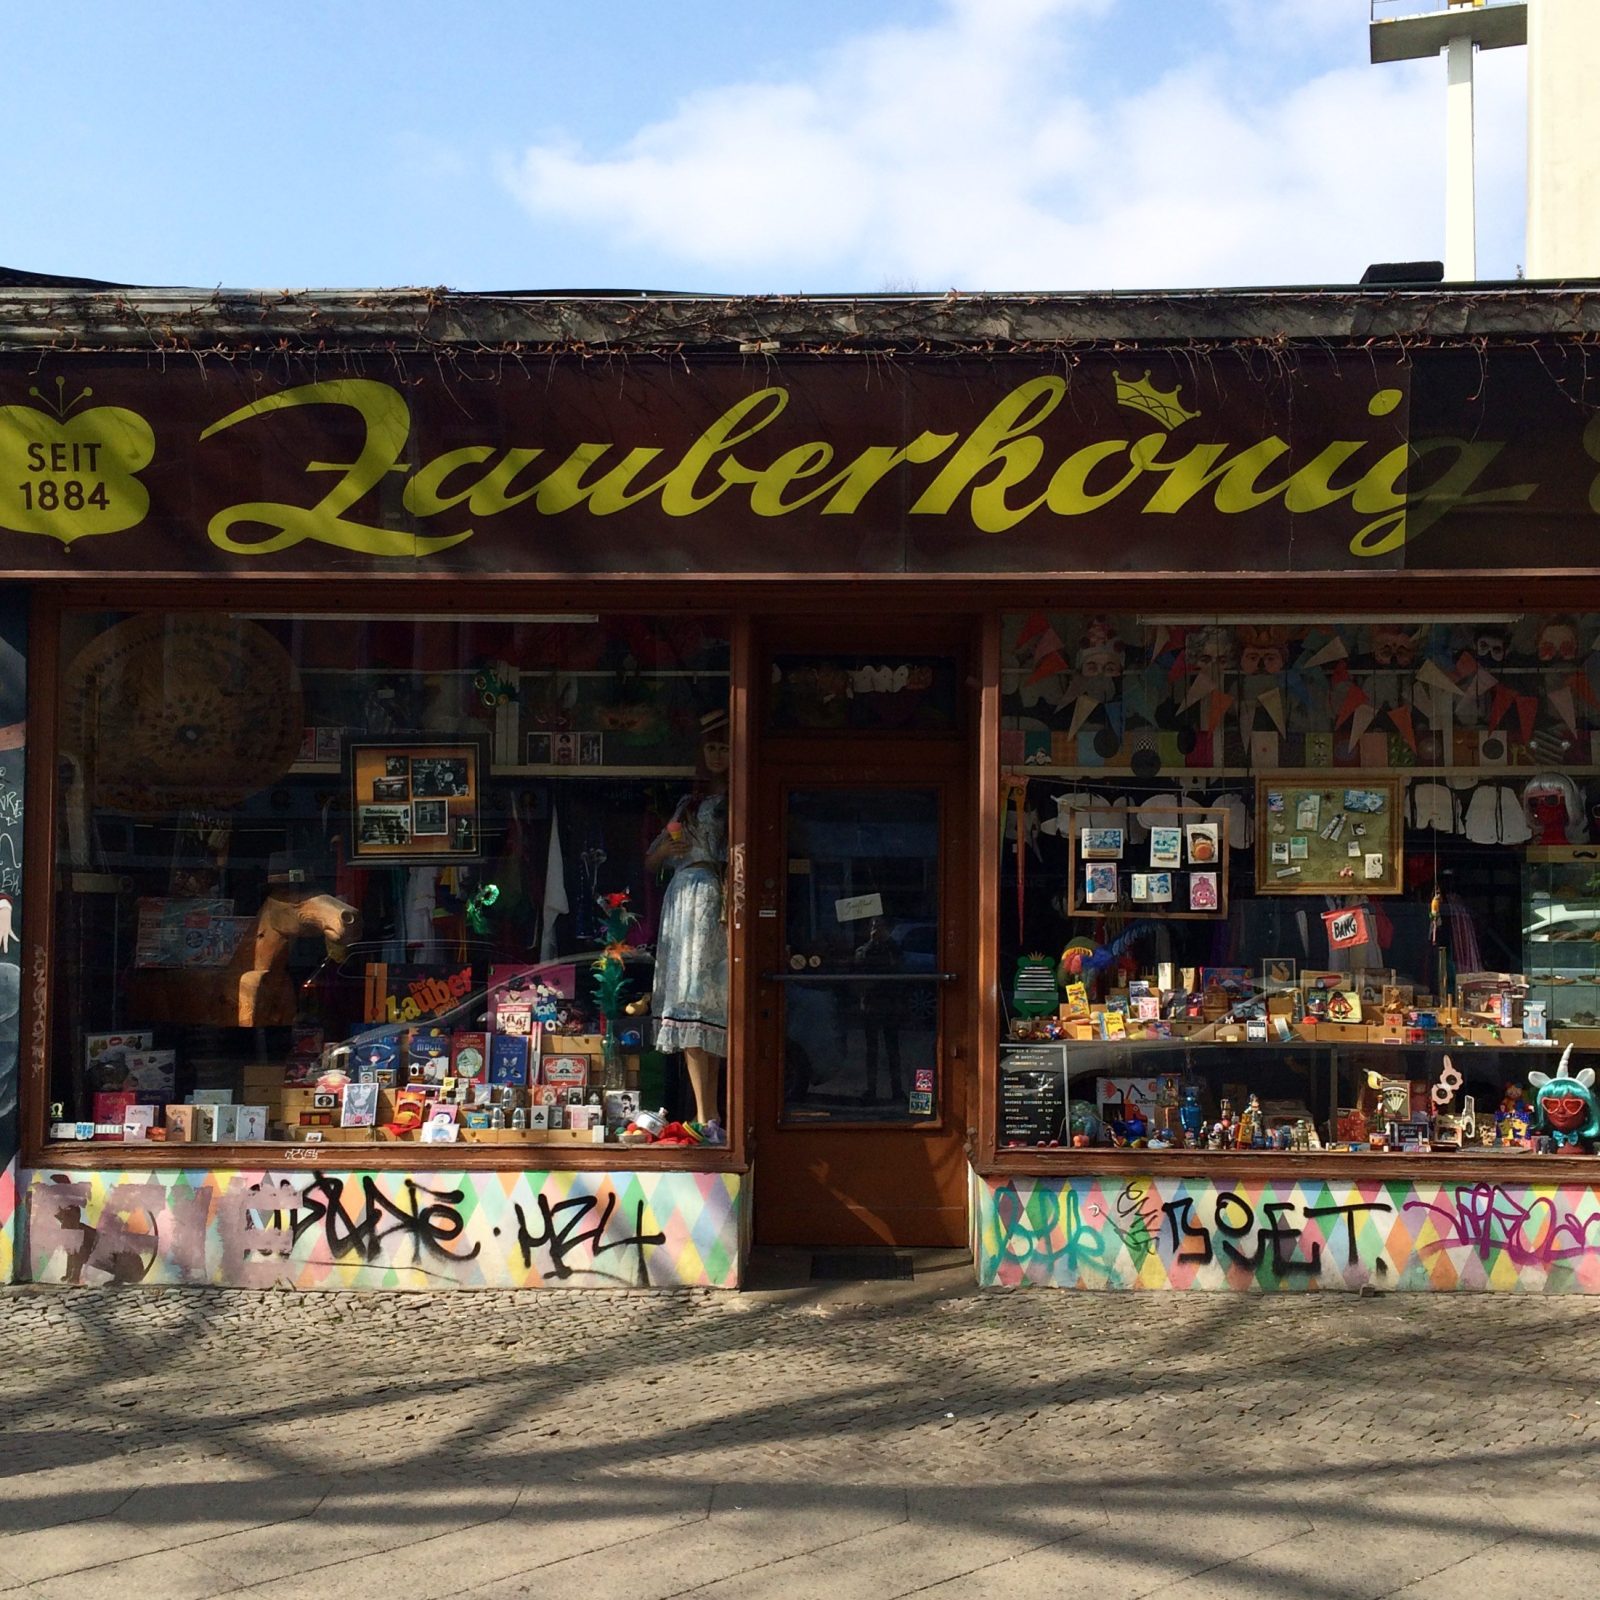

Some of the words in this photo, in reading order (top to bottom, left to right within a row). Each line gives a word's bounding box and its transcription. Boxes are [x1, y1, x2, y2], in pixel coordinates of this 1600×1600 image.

[27, 442, 102, 472] SEIT
[19, 480, 110, 511] 1884
[1333, 917, 1356, 939] BANG
